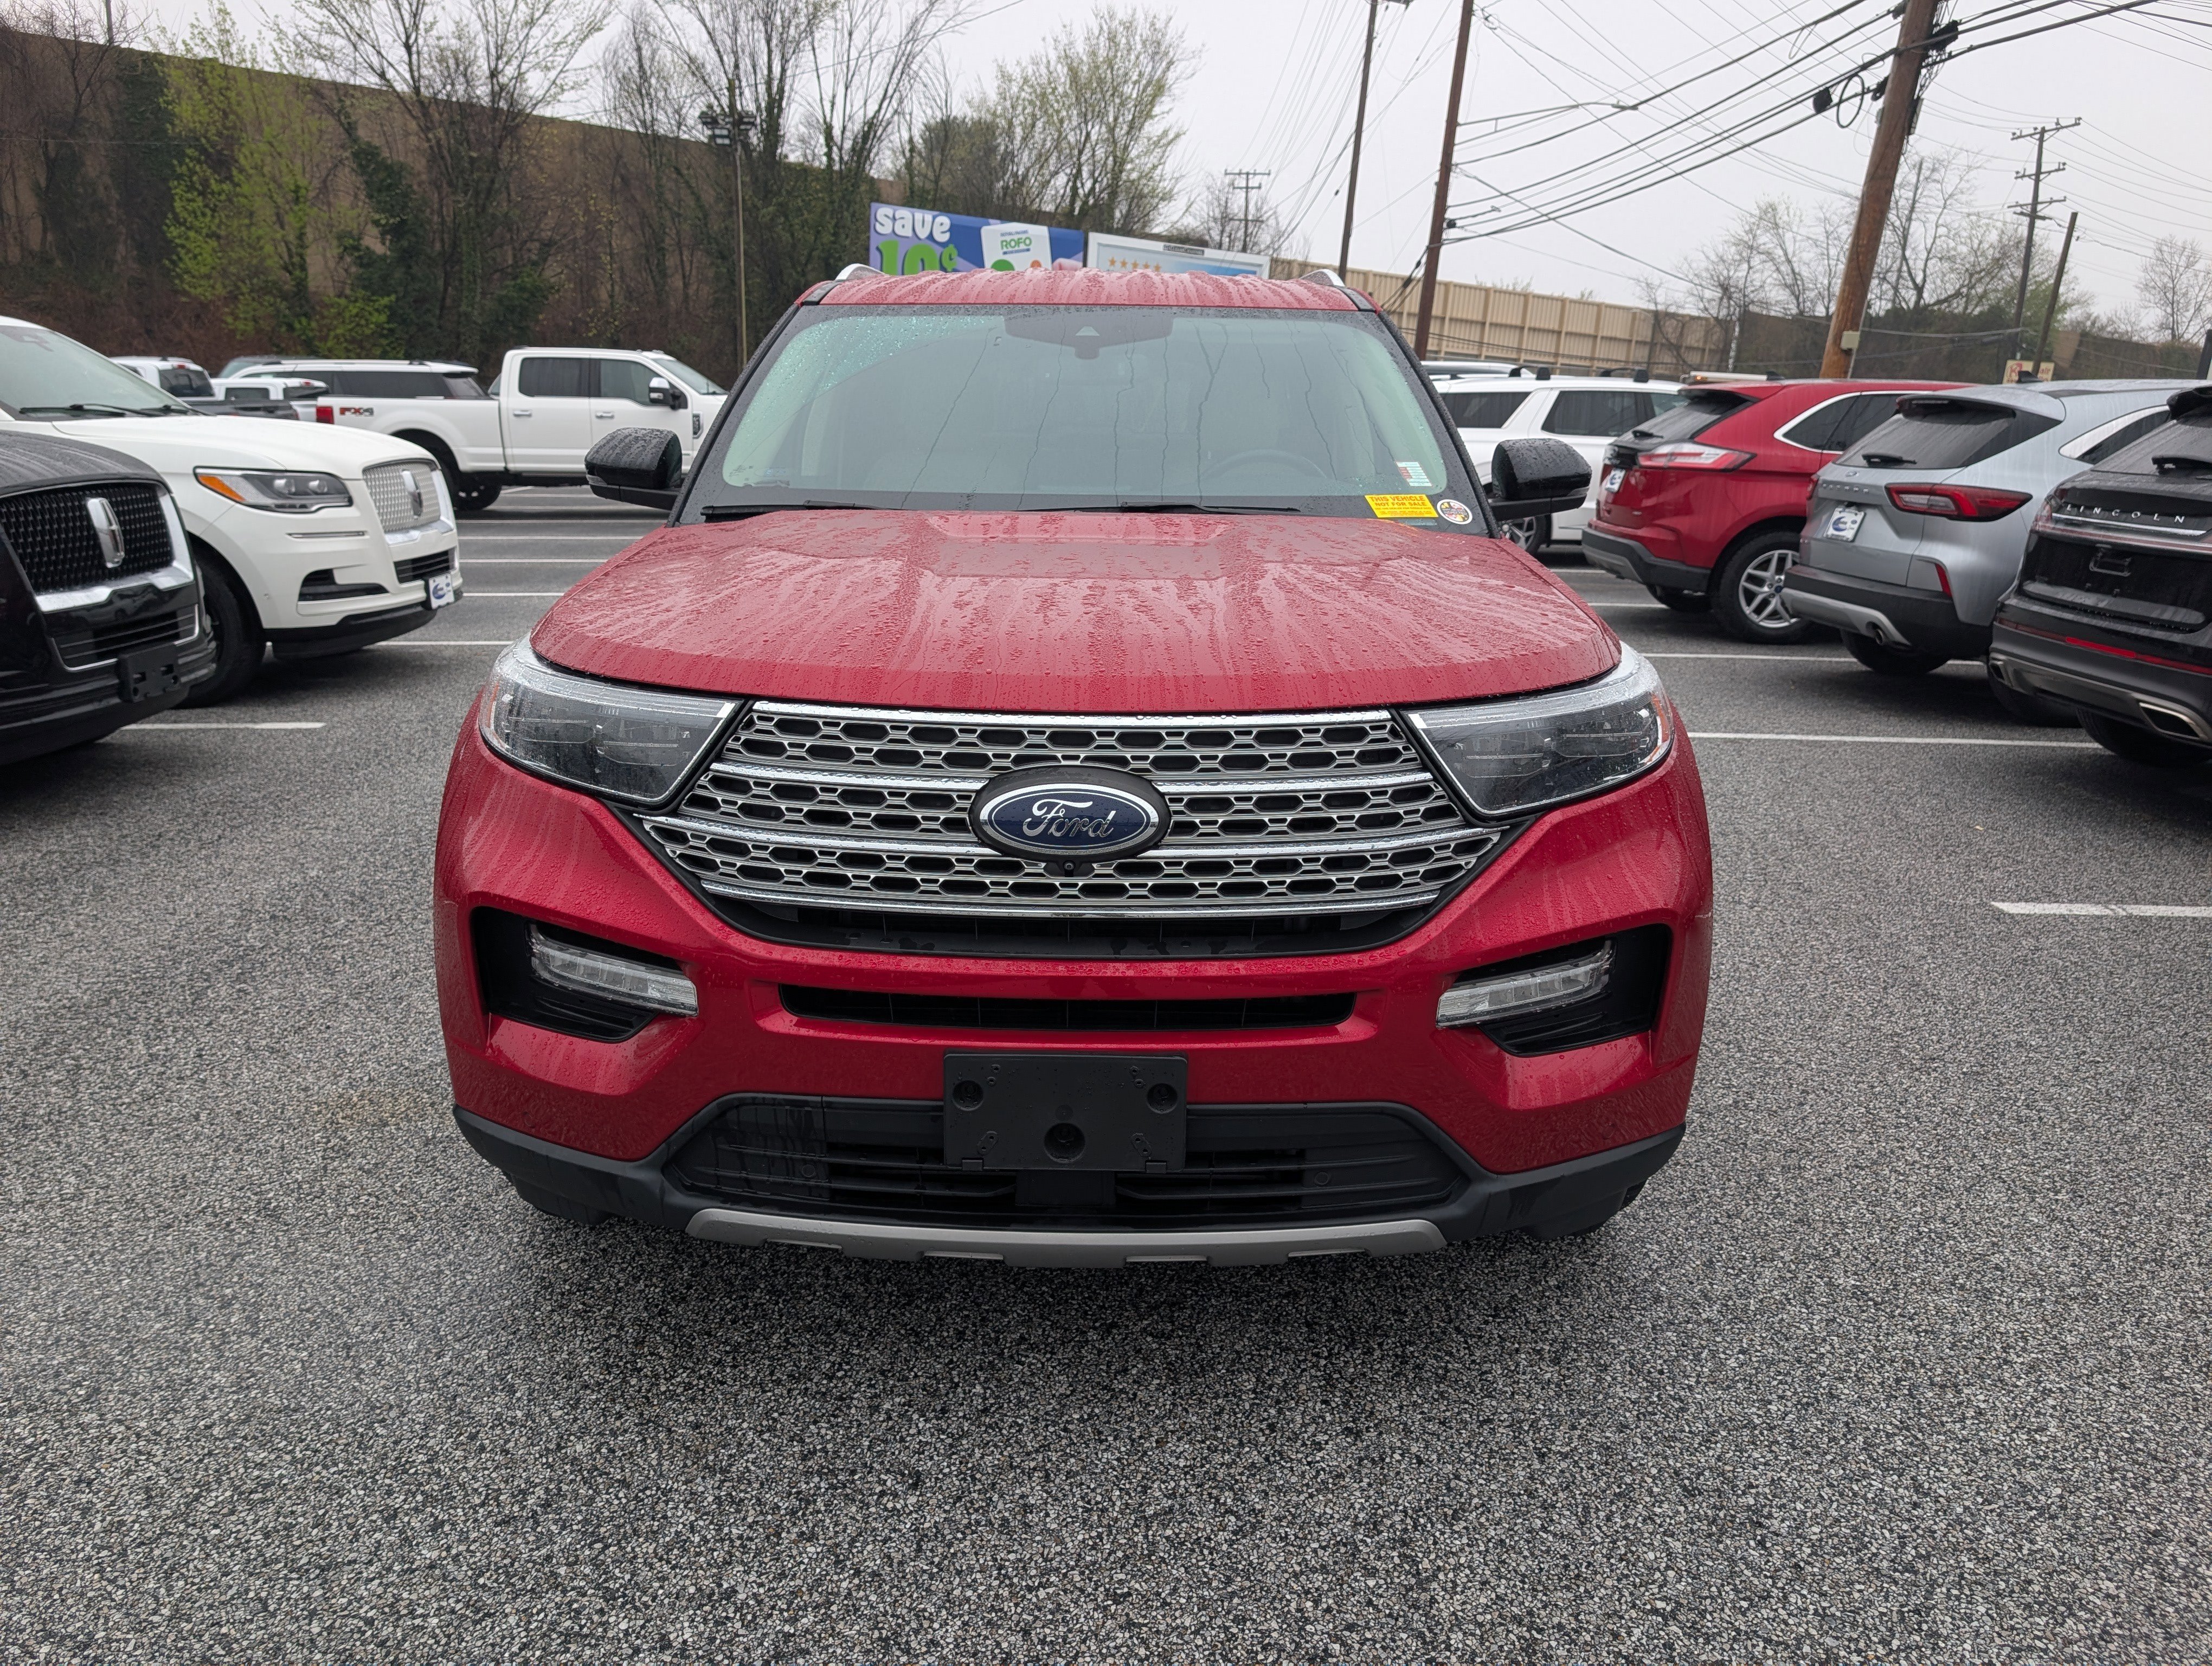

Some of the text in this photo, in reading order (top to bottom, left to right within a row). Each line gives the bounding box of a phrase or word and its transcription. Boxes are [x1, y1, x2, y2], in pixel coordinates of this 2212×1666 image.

[875, 207, 951, 242] save
[1000, 236, 1032, 250] ROFO
[339, 407, 374, 416] FX4
[2067, 504, 2185, 524] LINCOLN
[1023, 799, 1116, 838] Ford
